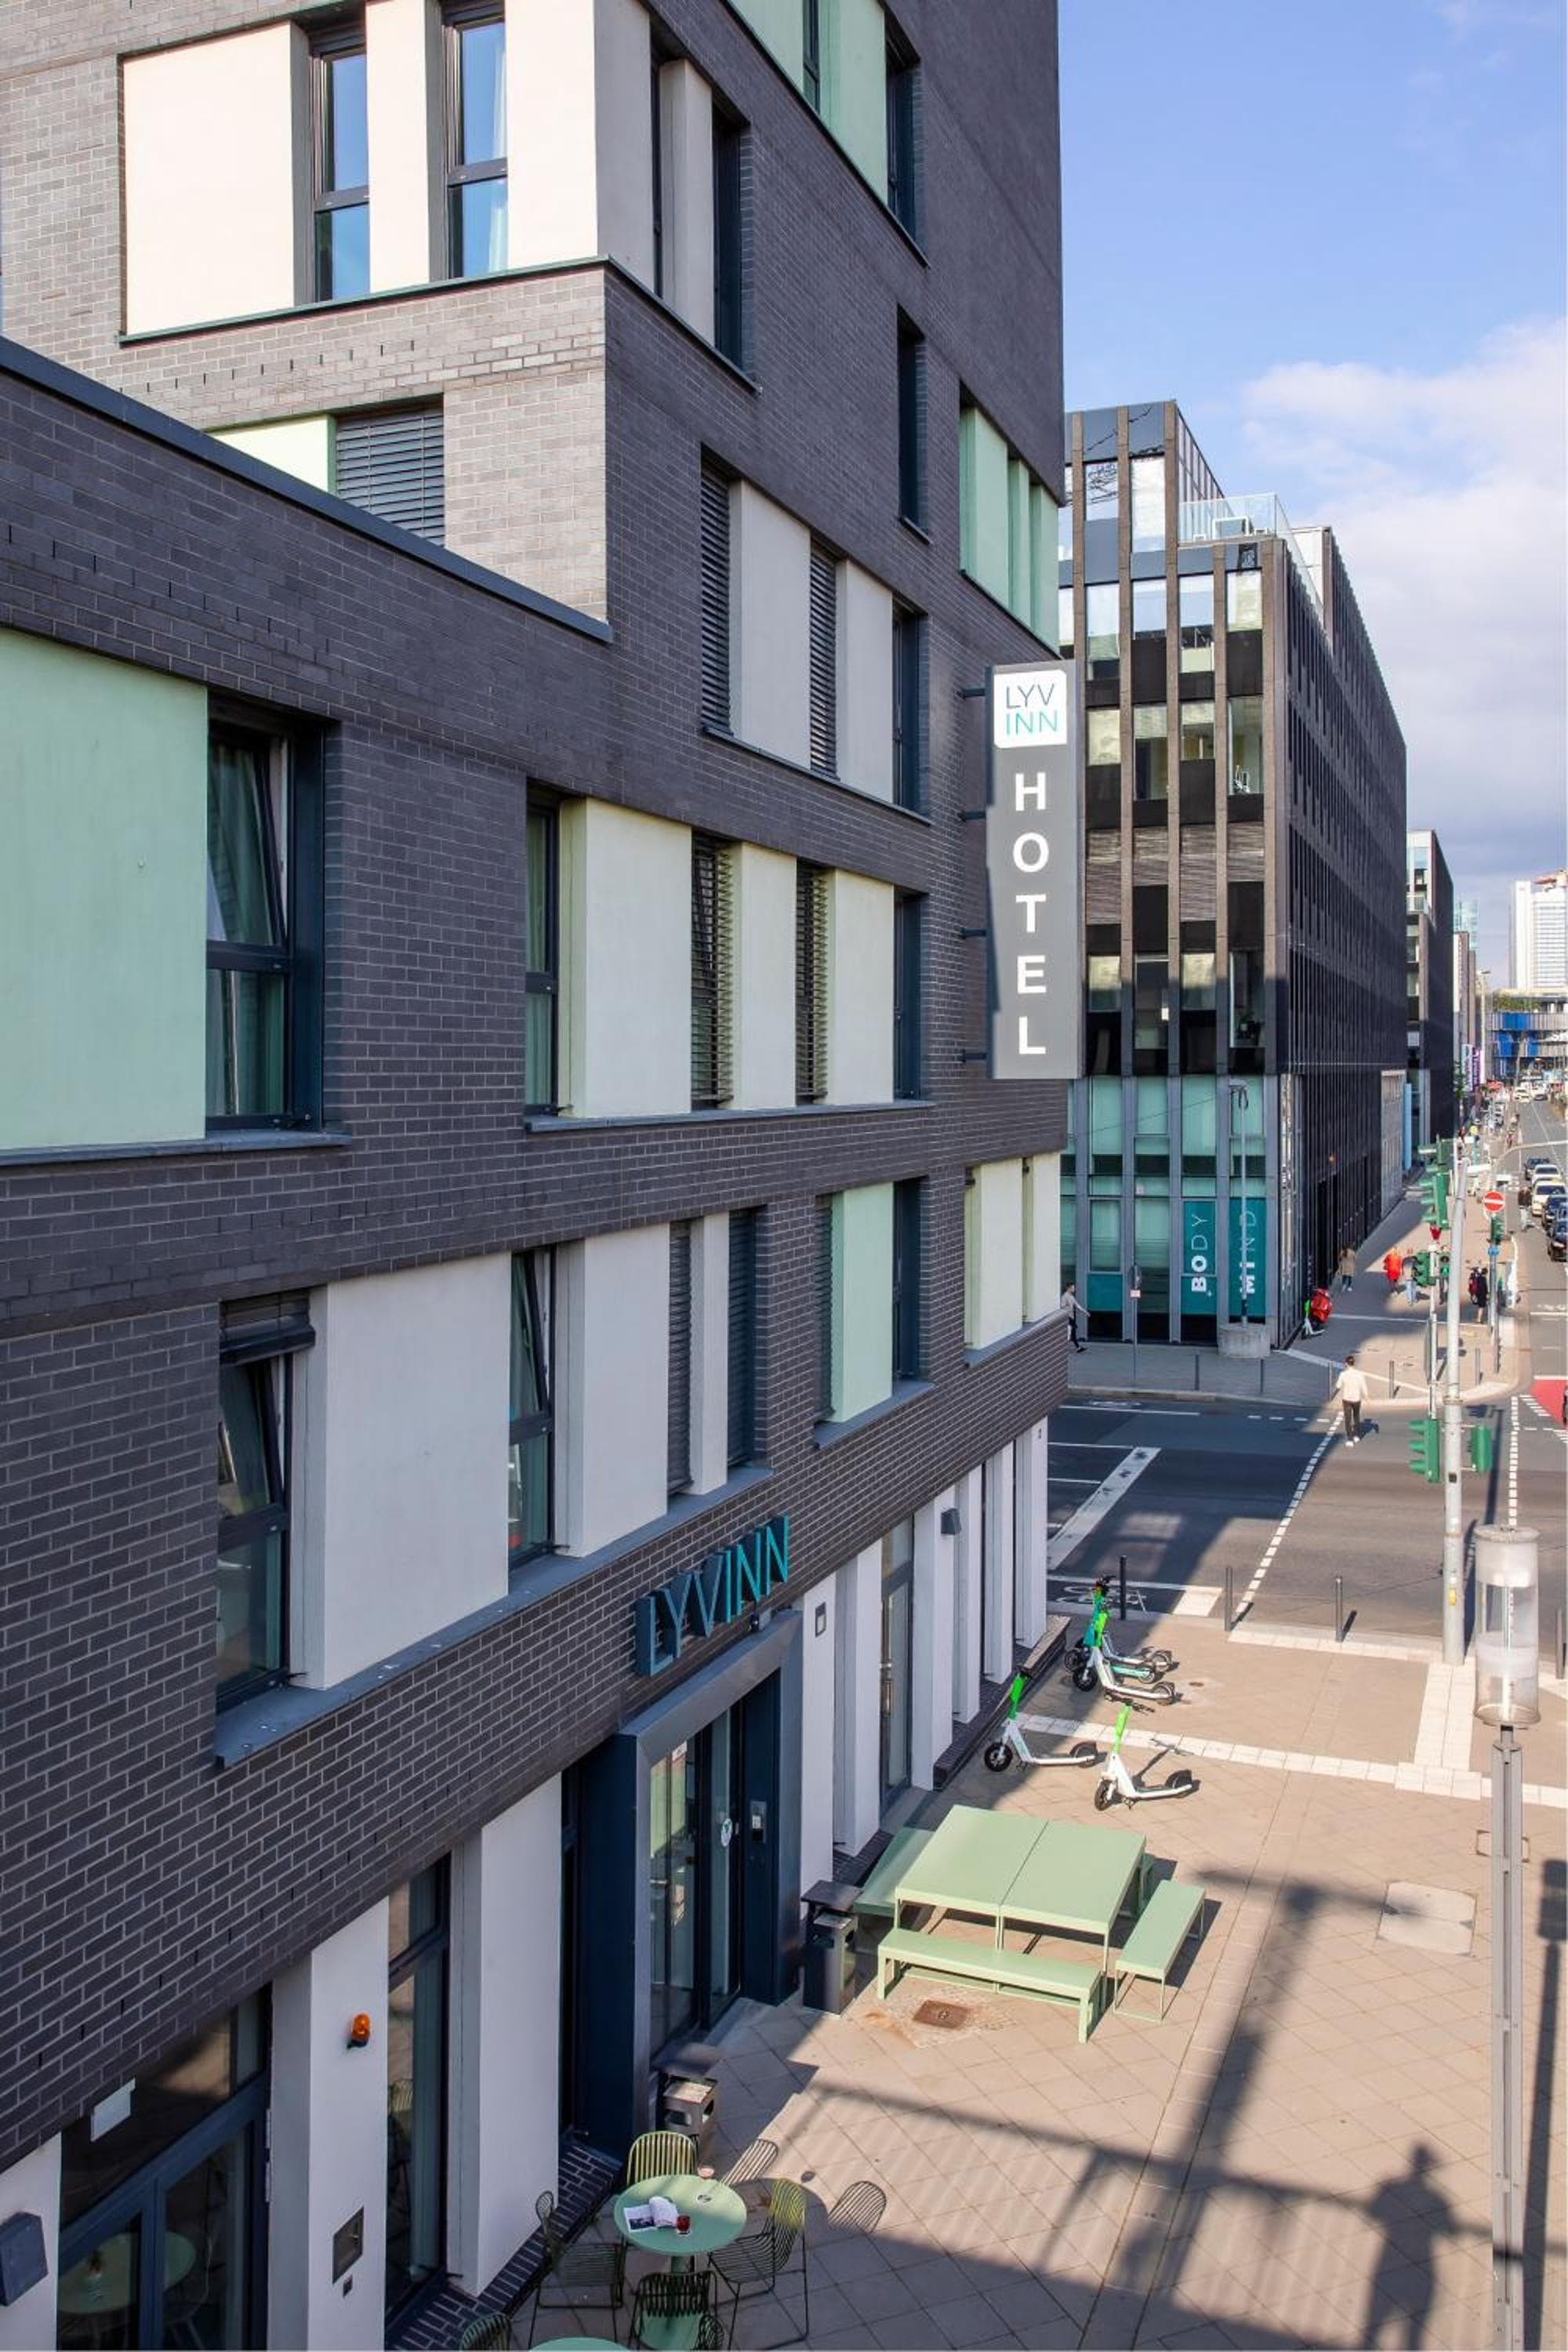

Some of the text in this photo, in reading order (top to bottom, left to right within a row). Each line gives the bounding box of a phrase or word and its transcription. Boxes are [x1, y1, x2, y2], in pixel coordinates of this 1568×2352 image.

[1006, 683, 1054, 710] LYV
[1006, 710, 1058, 735] INN
[1012, 772, 1050, 1055] HOTEL
[1191, 1214, 1208, 1293] BODY
[644, 1515, 789, 1678] LYVINN
